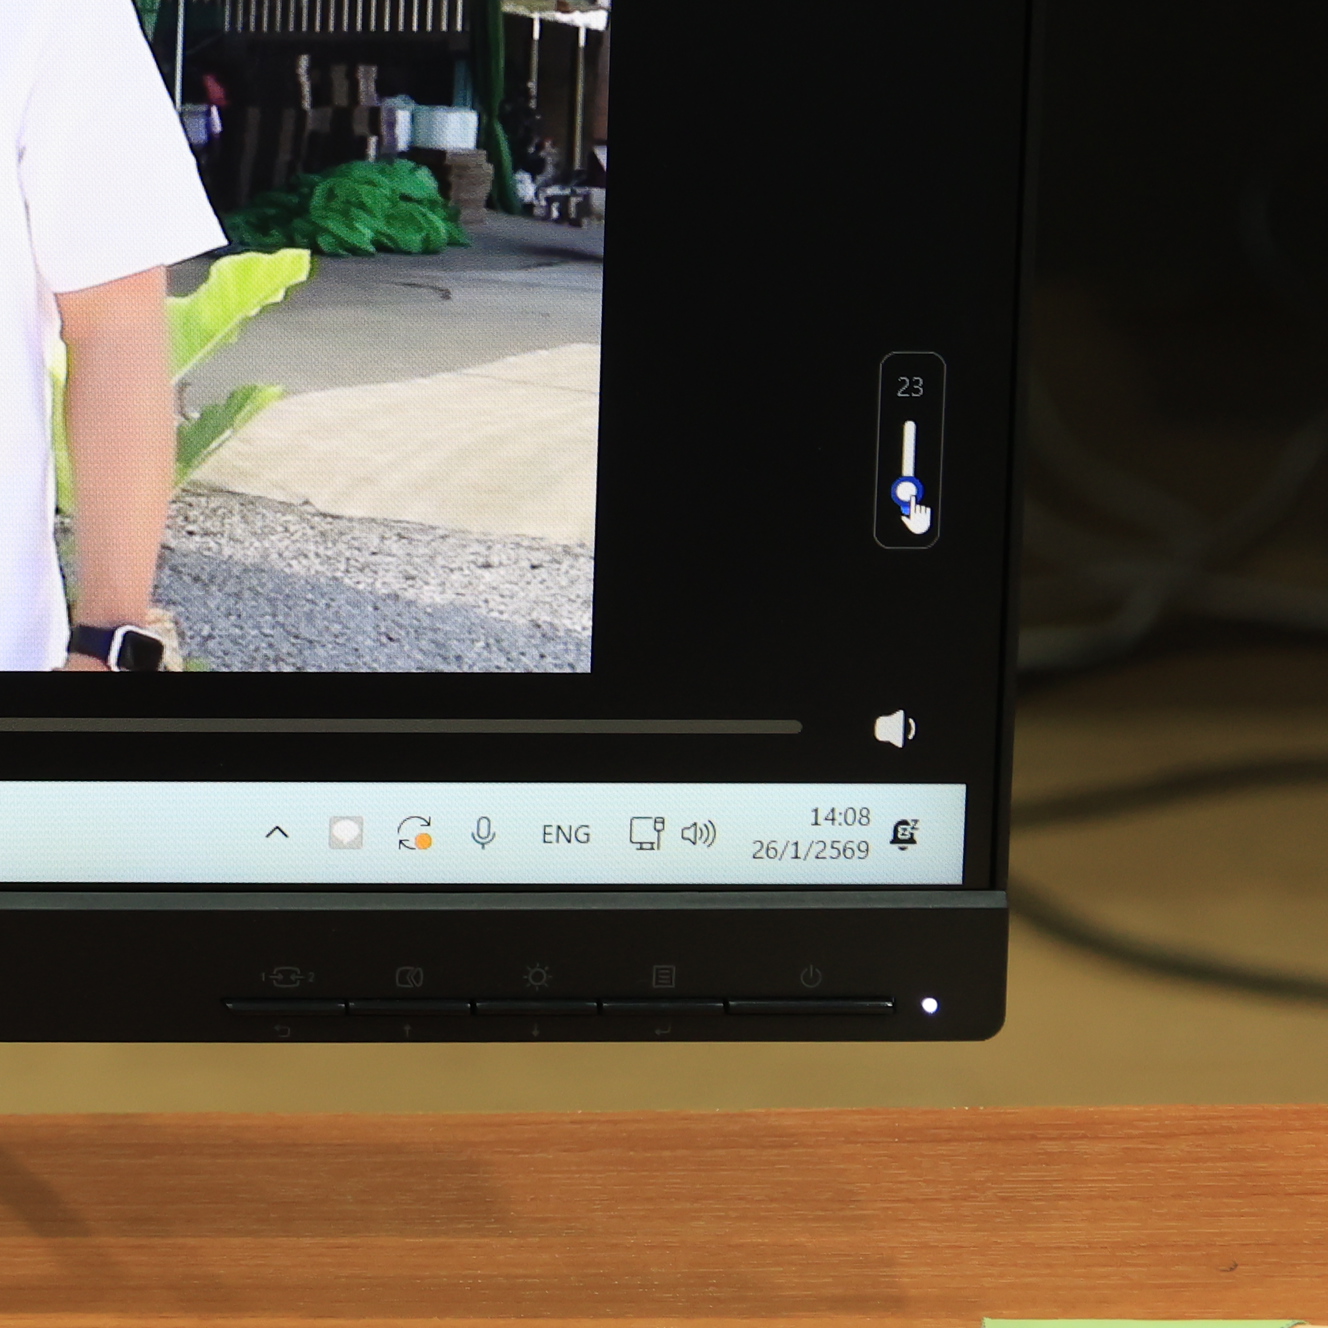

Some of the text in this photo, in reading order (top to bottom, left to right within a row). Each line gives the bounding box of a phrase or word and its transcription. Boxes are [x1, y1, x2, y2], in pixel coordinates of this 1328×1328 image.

[897, 377, 924, 397] 23
[810, 806, 871, 827] 14:08
[542, 824, 592, 845] ENG
[752, 840, 870, 861] 26/1/2569
